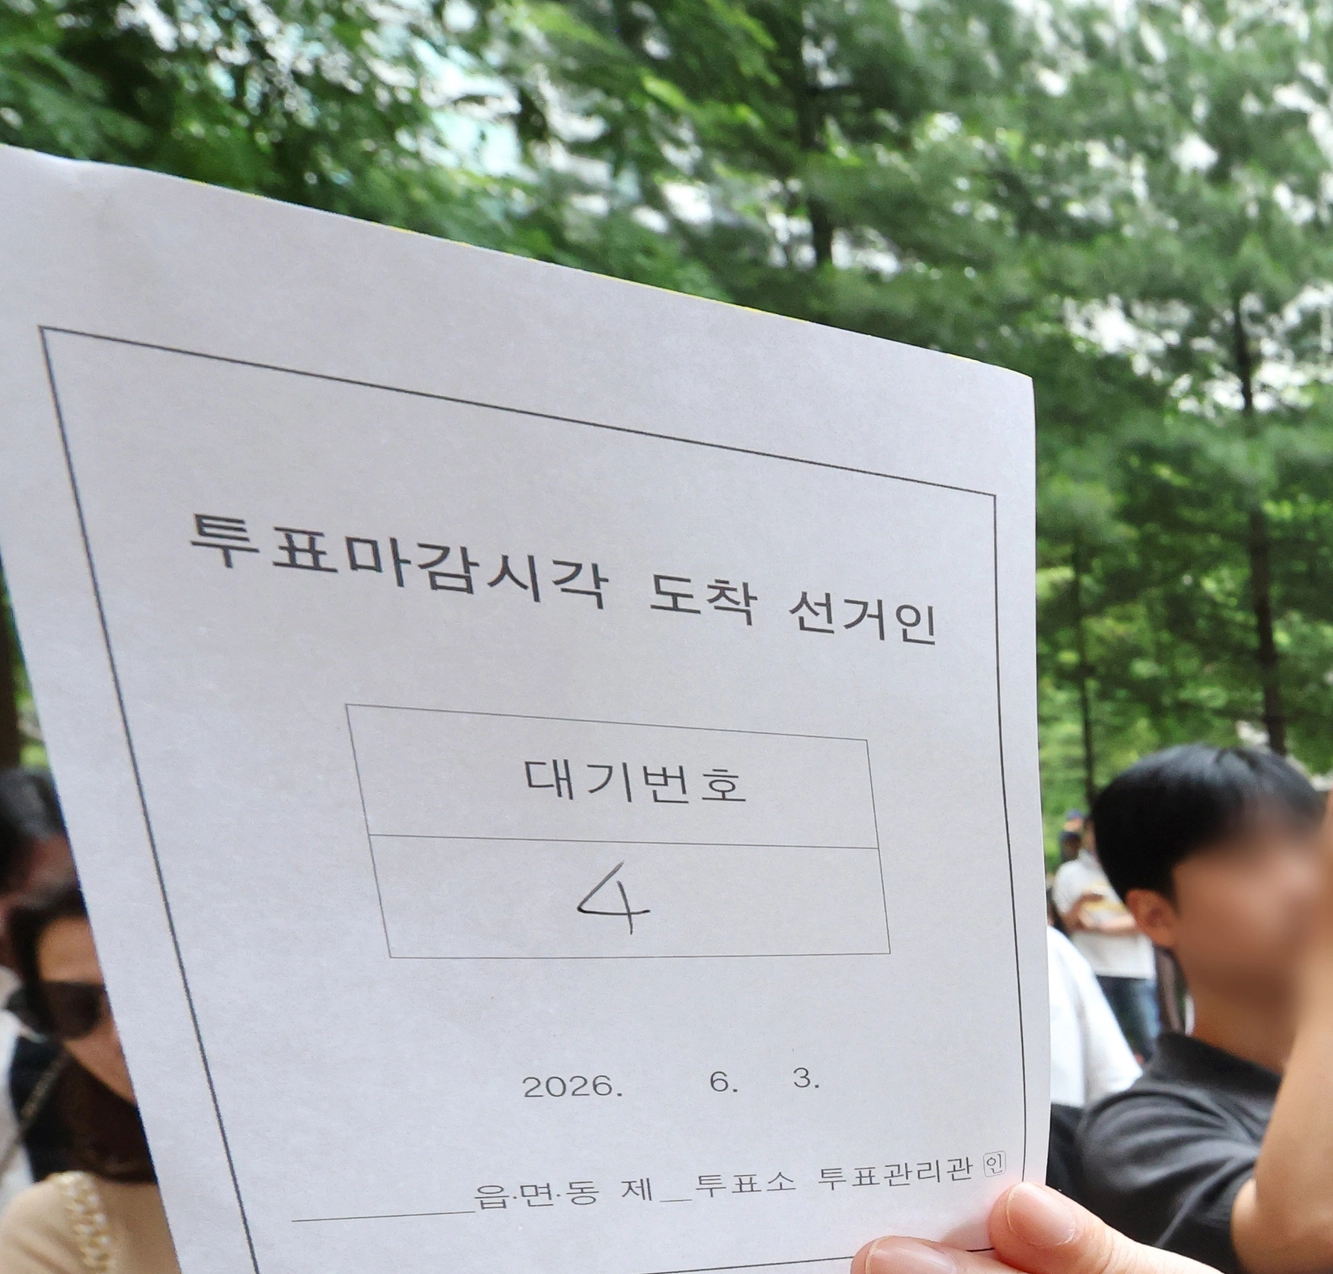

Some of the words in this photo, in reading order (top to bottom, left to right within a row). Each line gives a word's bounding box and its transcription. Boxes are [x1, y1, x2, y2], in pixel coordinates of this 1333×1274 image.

[190, 513, 610, 611] 투표마감시각
[649, 573, 759, 627] 도착
[788, 590, 936, 646] 선거인
[524, 758, 747, 805] 대기번호
[576, 861, 652, 936] 4
[521, 1074, 623, 1098] 2026.
[709, 1070, 739, 1093] 6.
[792, 1066, 820, 1089] 3.
[620, 1177, 653, 1202] 제
[694, 1171, 797, 1199] 투표소
[817, 1156, 974, 1192] 투표관리관
